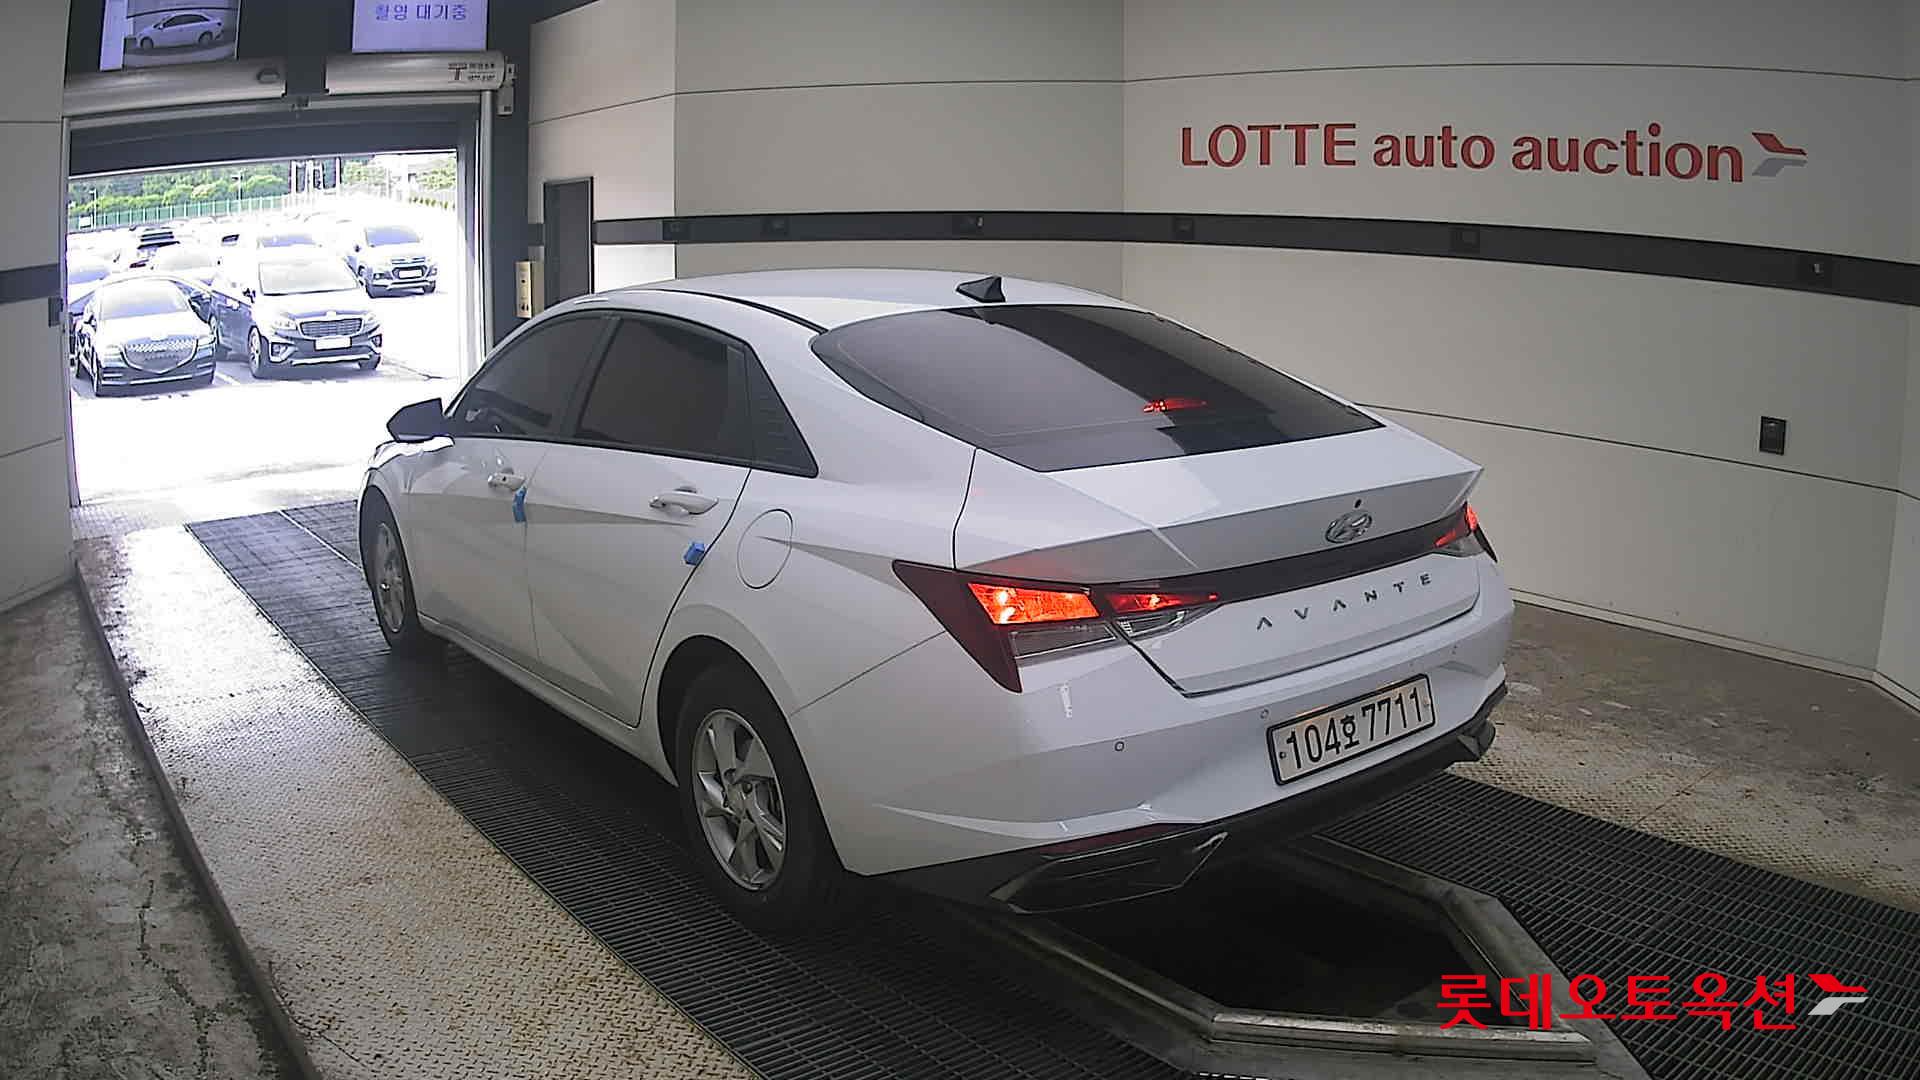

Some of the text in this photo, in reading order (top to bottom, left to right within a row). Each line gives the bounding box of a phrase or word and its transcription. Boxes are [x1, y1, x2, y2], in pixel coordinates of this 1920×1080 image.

[416, 3, 467, 21] 대기중
[1181, 122, 1744, 182] LOTTE auto auction
[1256, 573, 1432, 631] AVANTE
